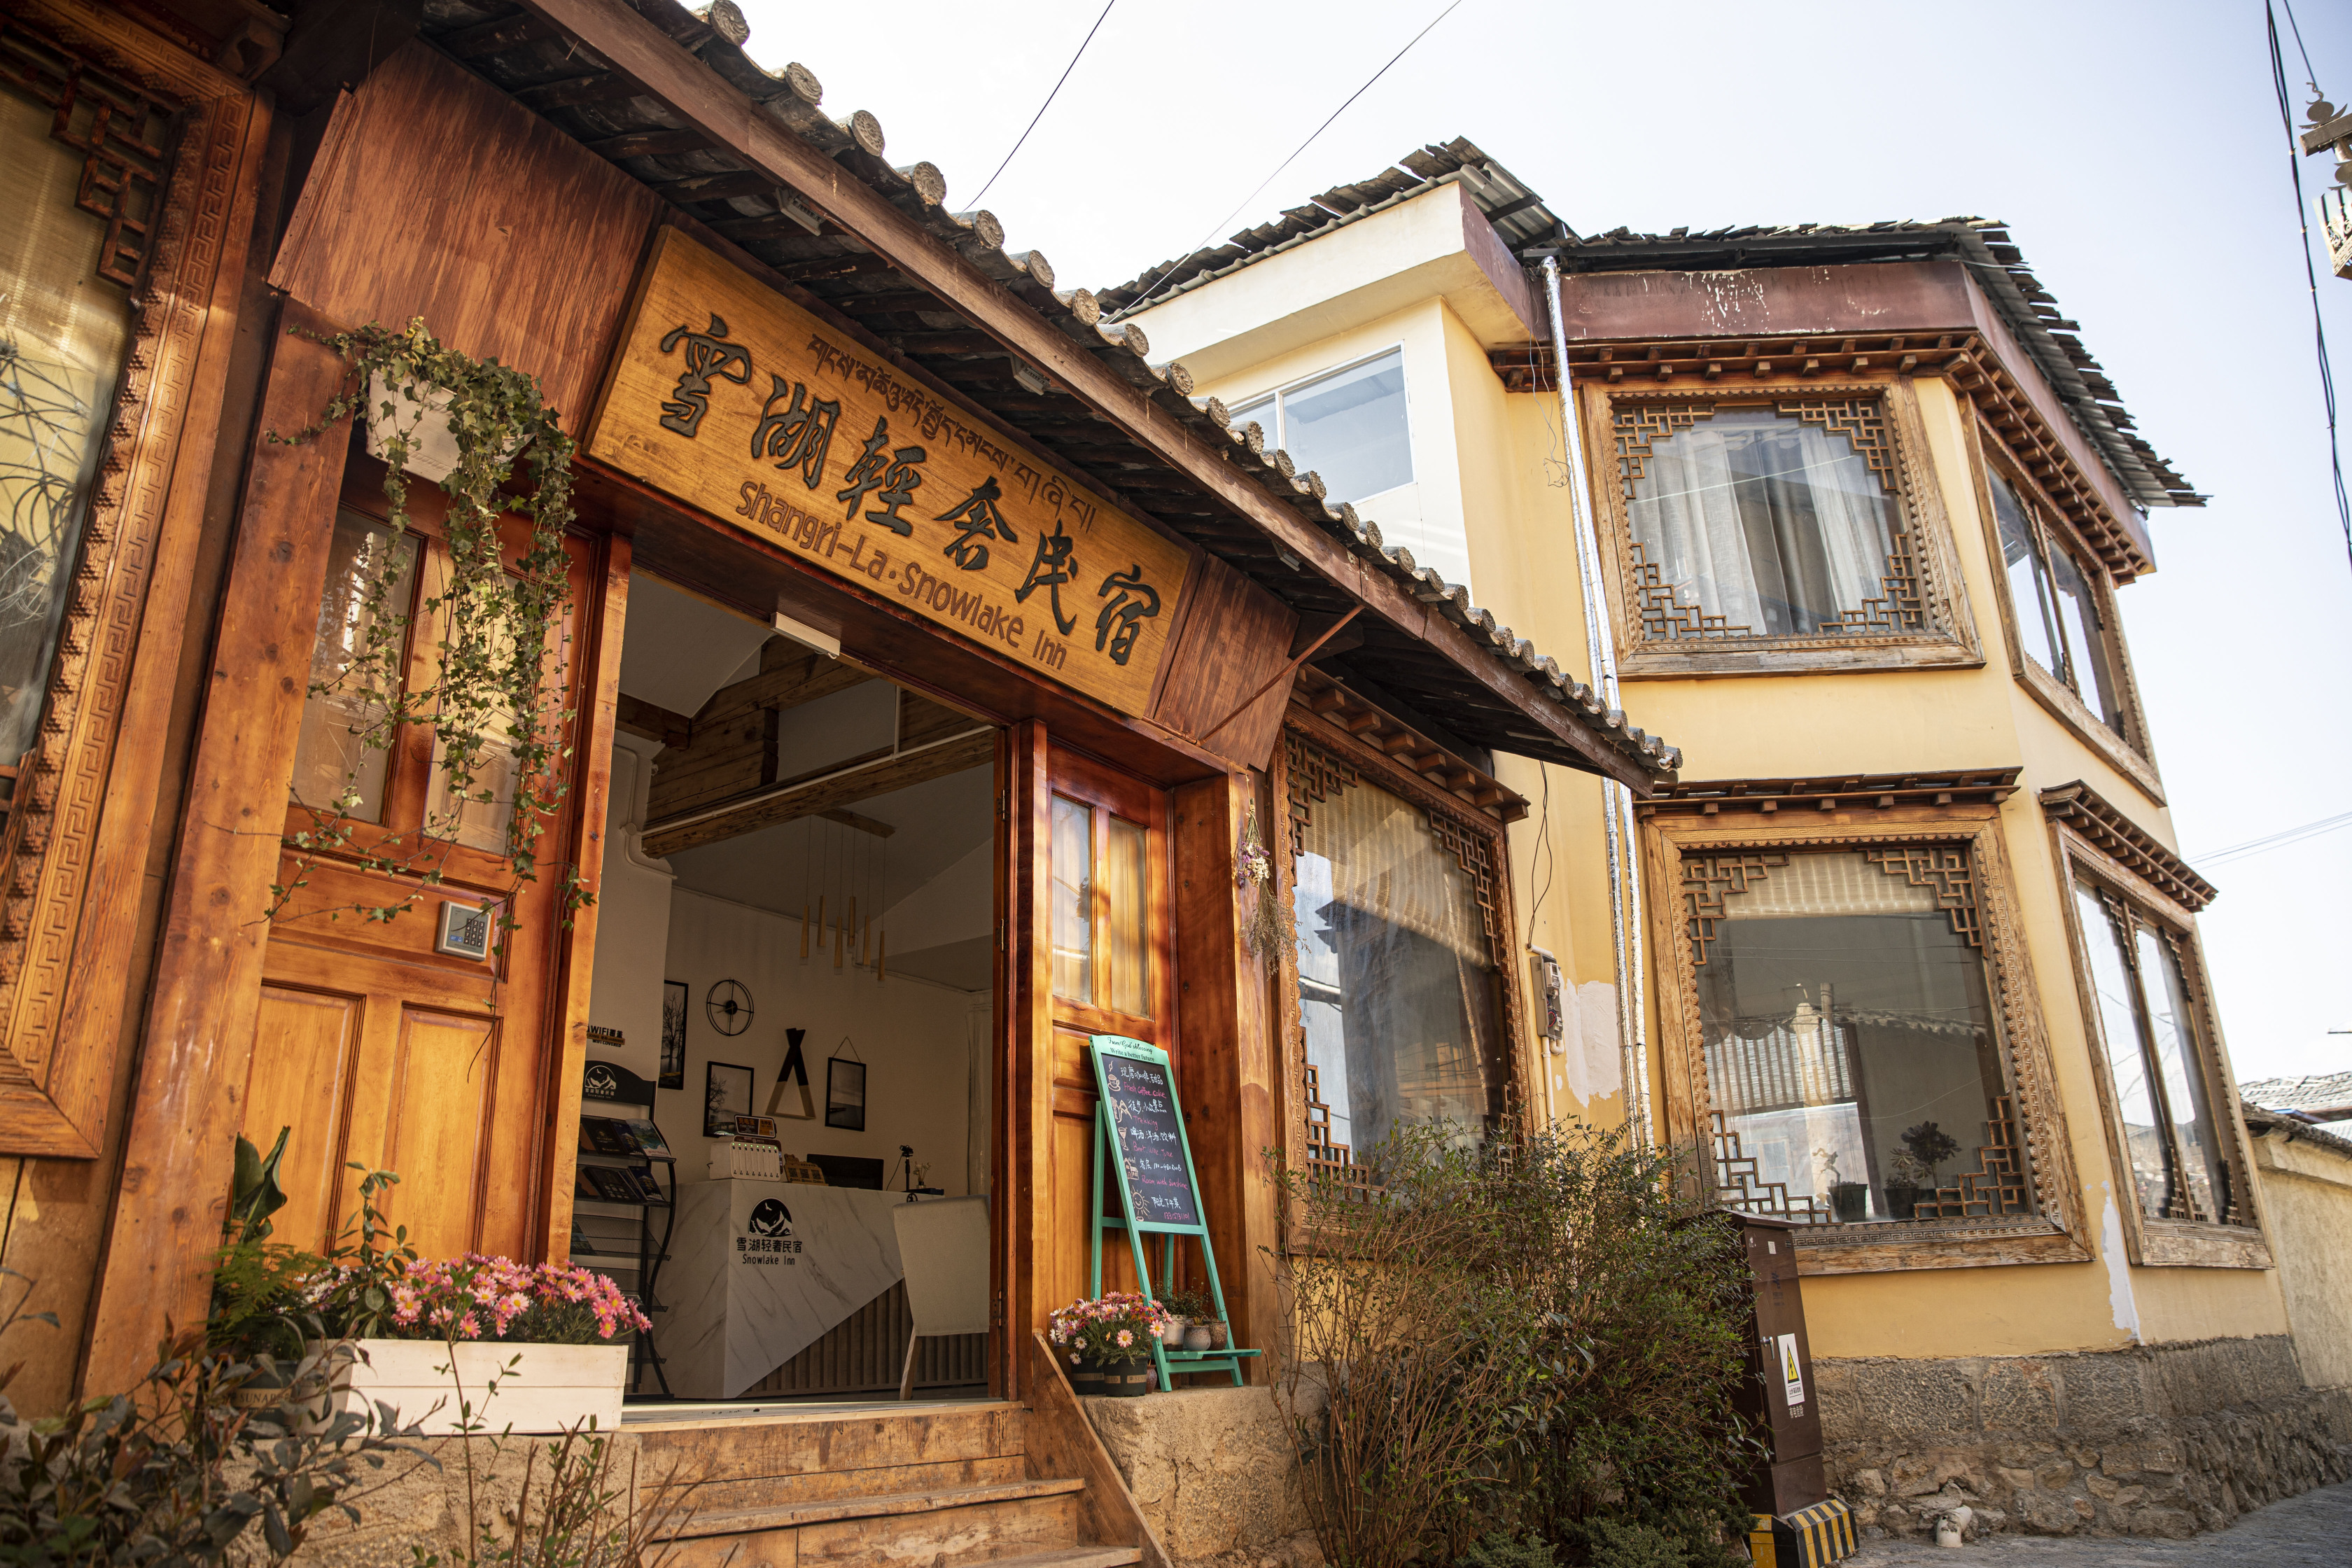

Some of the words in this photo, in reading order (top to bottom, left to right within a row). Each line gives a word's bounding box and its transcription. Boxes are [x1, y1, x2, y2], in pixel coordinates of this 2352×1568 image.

[1032, 629, 1068, 670] Inn
[1110, 1047, 1124, 1056] Write
[1127, 1051, 1141, 1060] better
[1133, 1115, 1158, 1130] Trekking
[1156, 1177, 1168, 1186] with
[736, 1237, 803, 1254] 雪湖轻奢民宿
[742, 1254, 779, 1265] Snowlake
[784, 1255, 795, 1265] Inn
